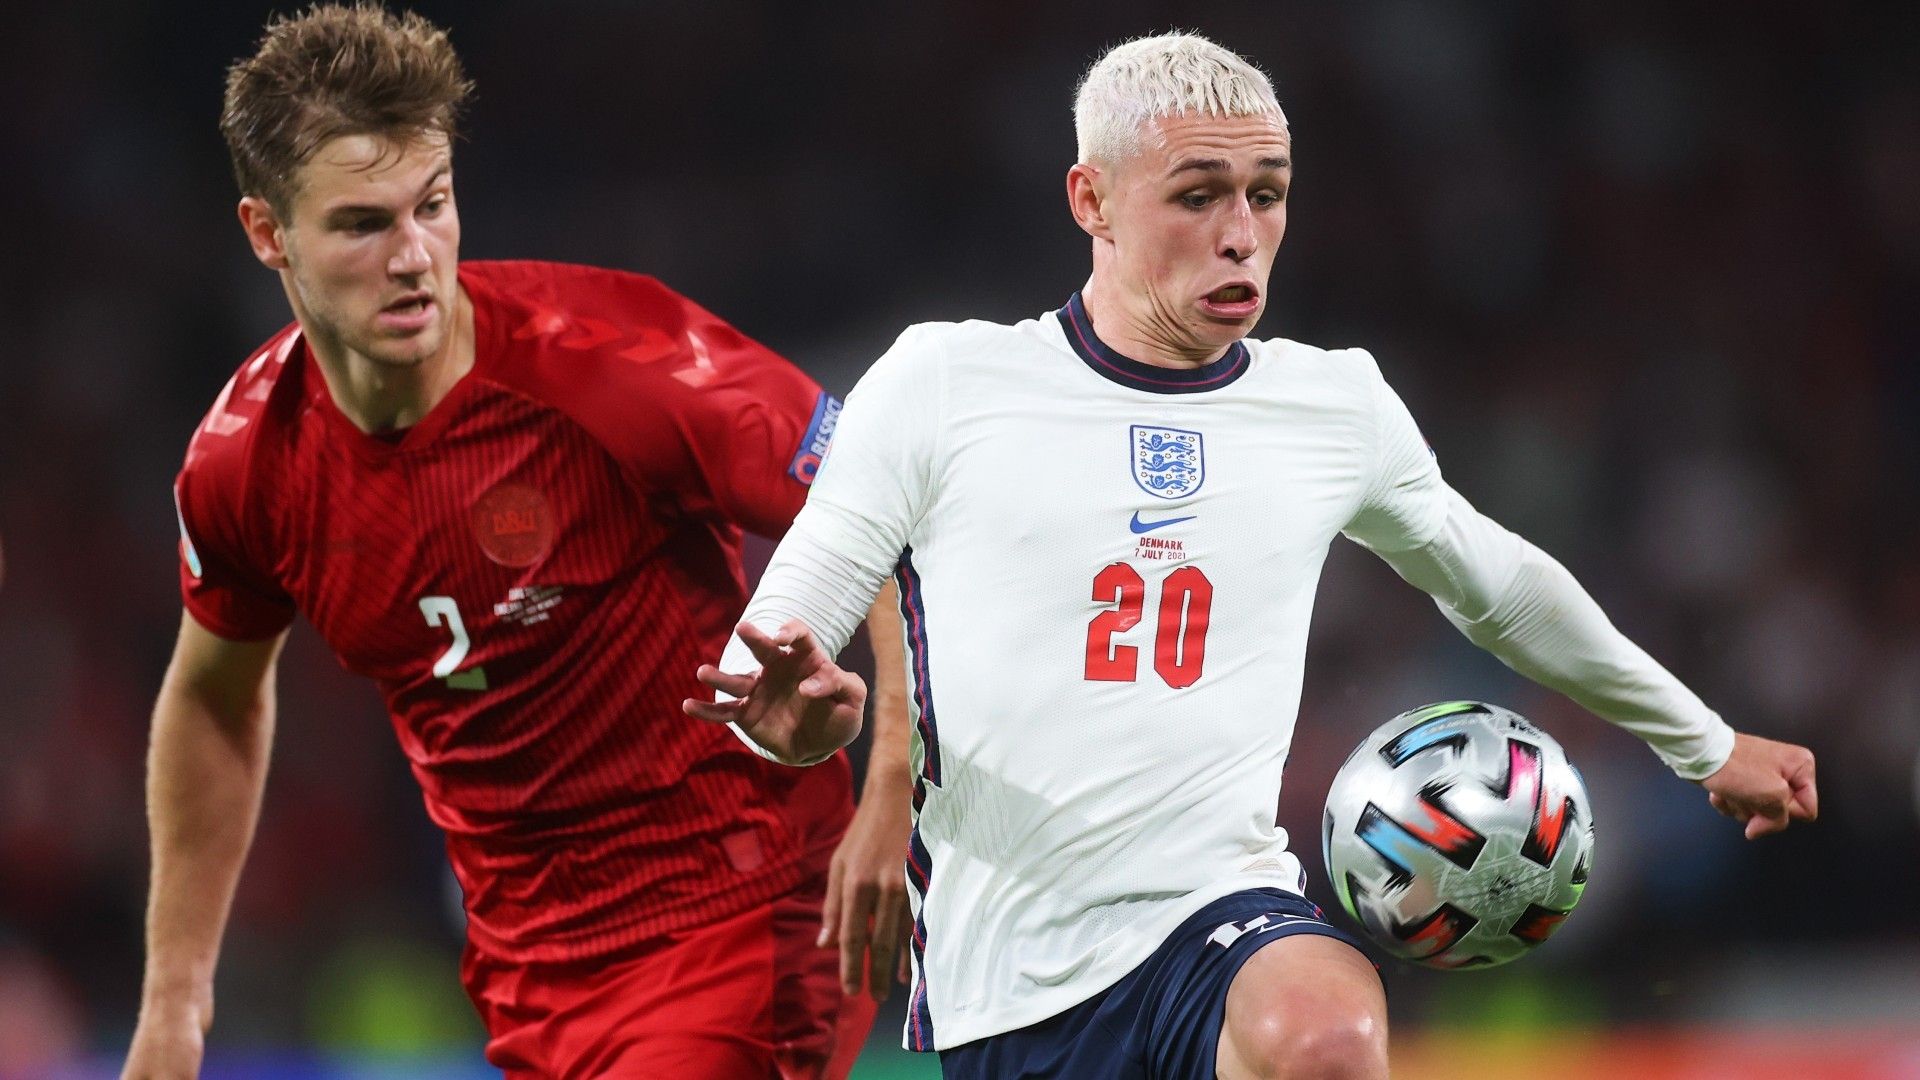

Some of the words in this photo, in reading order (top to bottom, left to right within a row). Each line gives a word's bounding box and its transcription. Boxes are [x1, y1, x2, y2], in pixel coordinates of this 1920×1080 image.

[1135, 548, 1140, 557] 7
[1142, 549, 1163, 560] JULY
[1167, 551, 1186, 560] 2021
[1140, 537, 1183, 550] DENMARK
[418, 596, 488, 690] 2
[1084, 562, 1213, 689] 20
